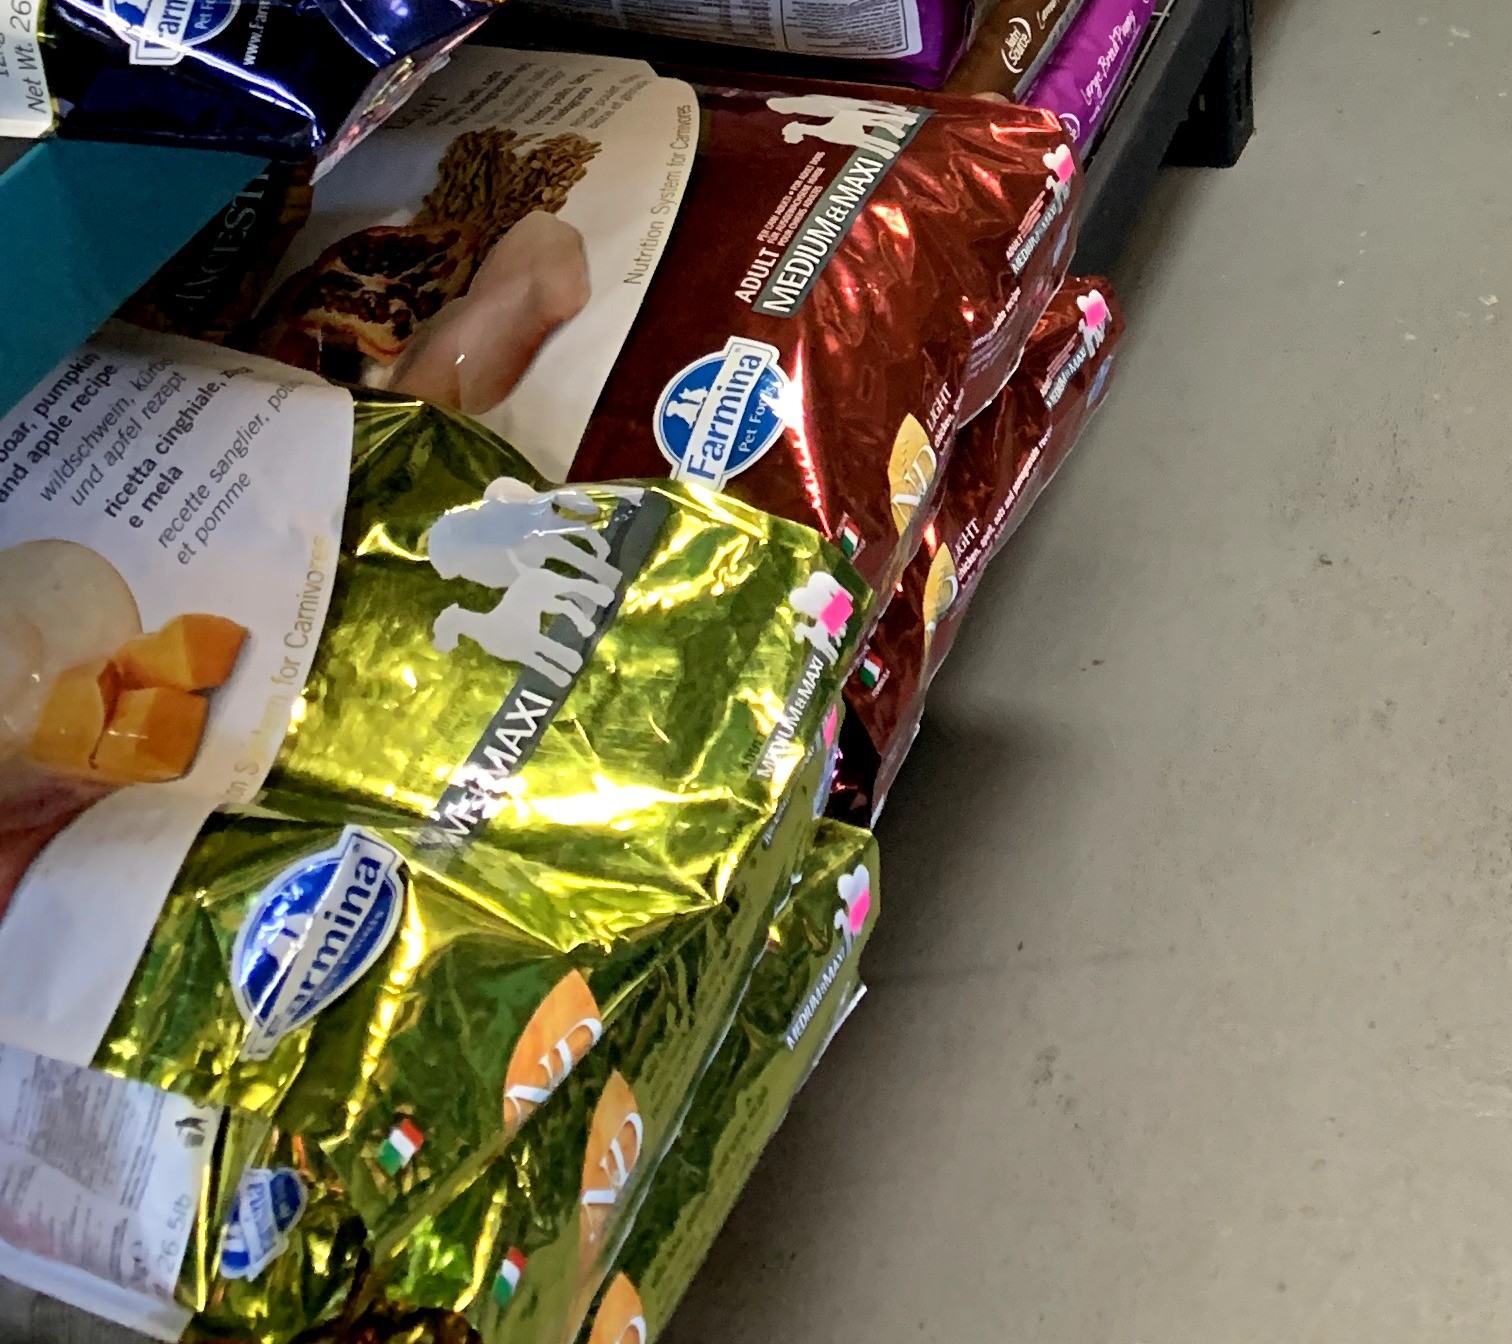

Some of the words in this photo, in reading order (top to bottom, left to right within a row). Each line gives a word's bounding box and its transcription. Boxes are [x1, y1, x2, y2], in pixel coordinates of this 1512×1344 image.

[15, 34, 38, 73] Wt.
[27, 78, 49, 113] Net
[658, 174, 682, 217] System
[668, 154, 688, 174] for
[623, 220, 664, 285] Nutrition
[762, 216, 842, 313] MEDIUM
[828, 155, 885, 210] MAXI
[734, 246, 780, 304] ADULT
[30, 418, 73, 470] apple
[70, 361, 120, 419] recipe
[32, 351, 101, 418] pumpkin
[686, 351, 766, 481] Farmina
[40, 392, 138, 502] wildschwein,
[71, 468, 104, 507] und
[103, 418, 144, 471] apfel
[139, 369, 188, 422] rezept
[103, 457, 158, 519] ricetta
[154, 378, 228, 458] cinghiale,
[738, 425, 758, 453] Pet
[129, 512, 144, 529] e
[139, 464, 185, 512] mela
[157, 486, 212, 550] recette
[208, 410, 271, 485] sanglier,
[176, 542, 198, 566] et
[196, 469, 253, 546] pomme
[283, 533, 326, 650] Carnivores
[270, 649, 302, 688] for
